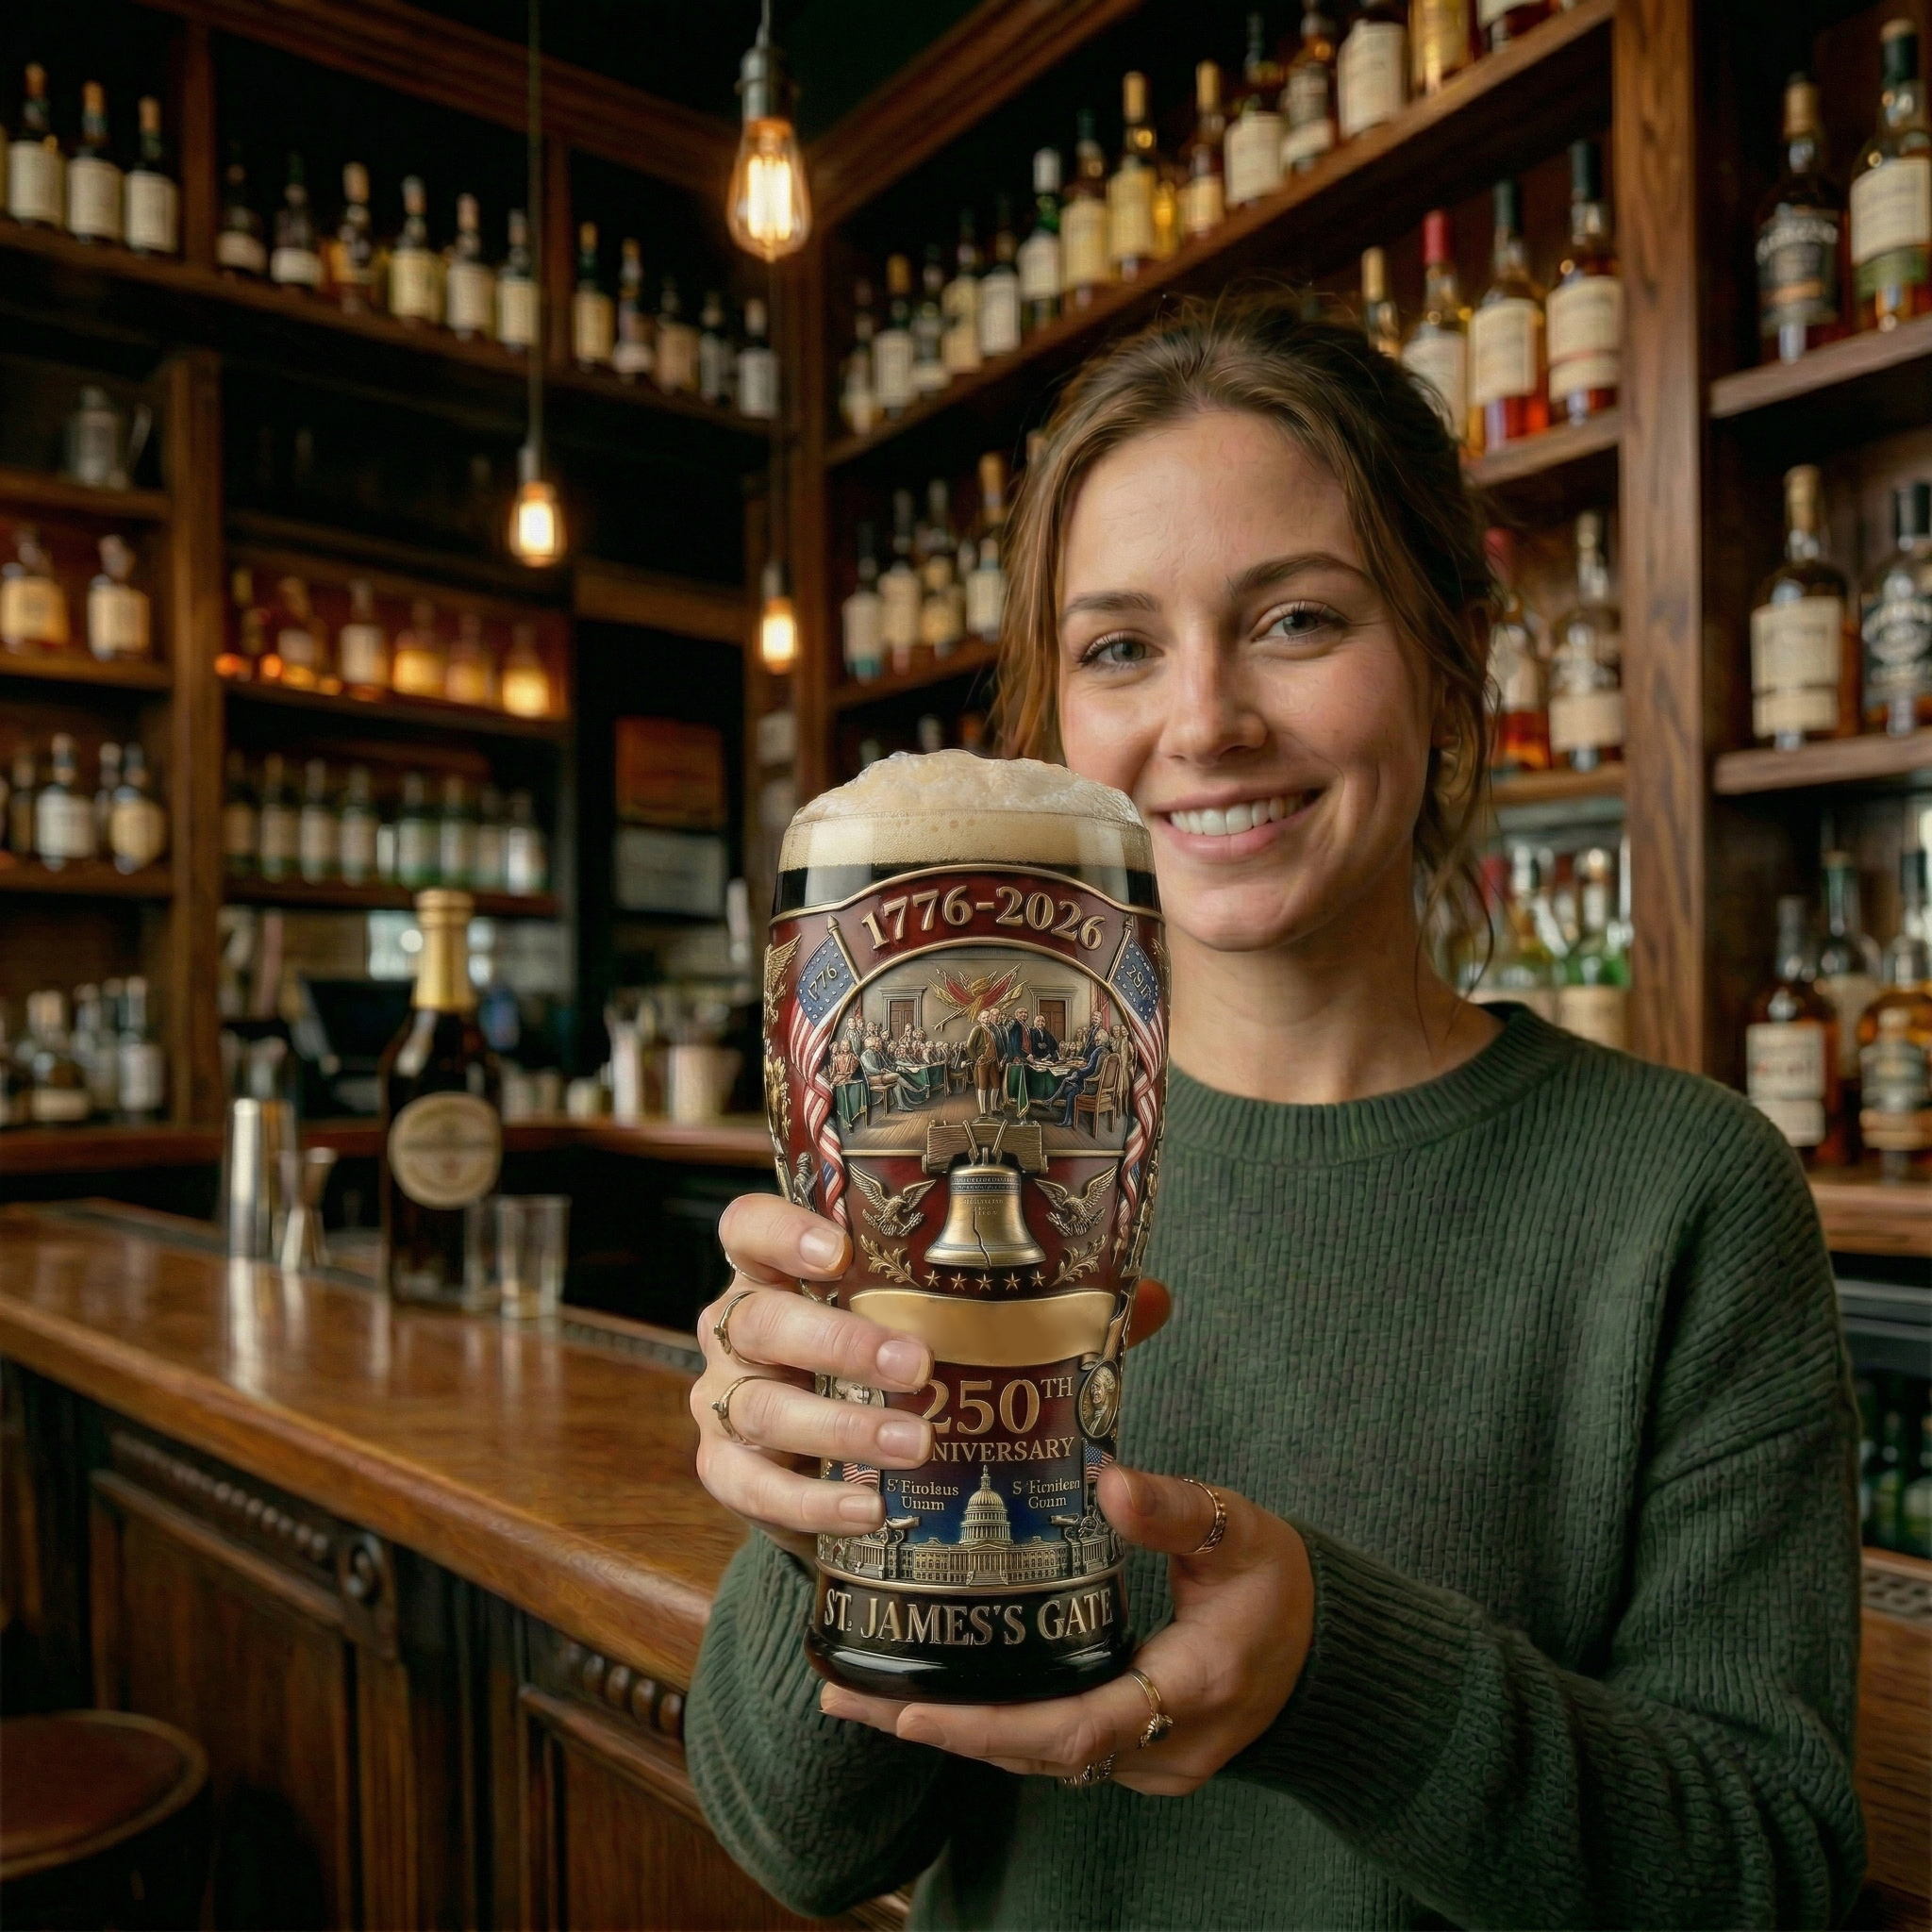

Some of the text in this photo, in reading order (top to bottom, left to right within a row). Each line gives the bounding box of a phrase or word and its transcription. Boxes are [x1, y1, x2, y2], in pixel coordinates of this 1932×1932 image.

[860, 885, 1106, 951] 1776-2026
[930, 1437, 1075, 1462] NIVERSARY
[824, 1587, 1114, 1646] ST. JAMES'S GATE
